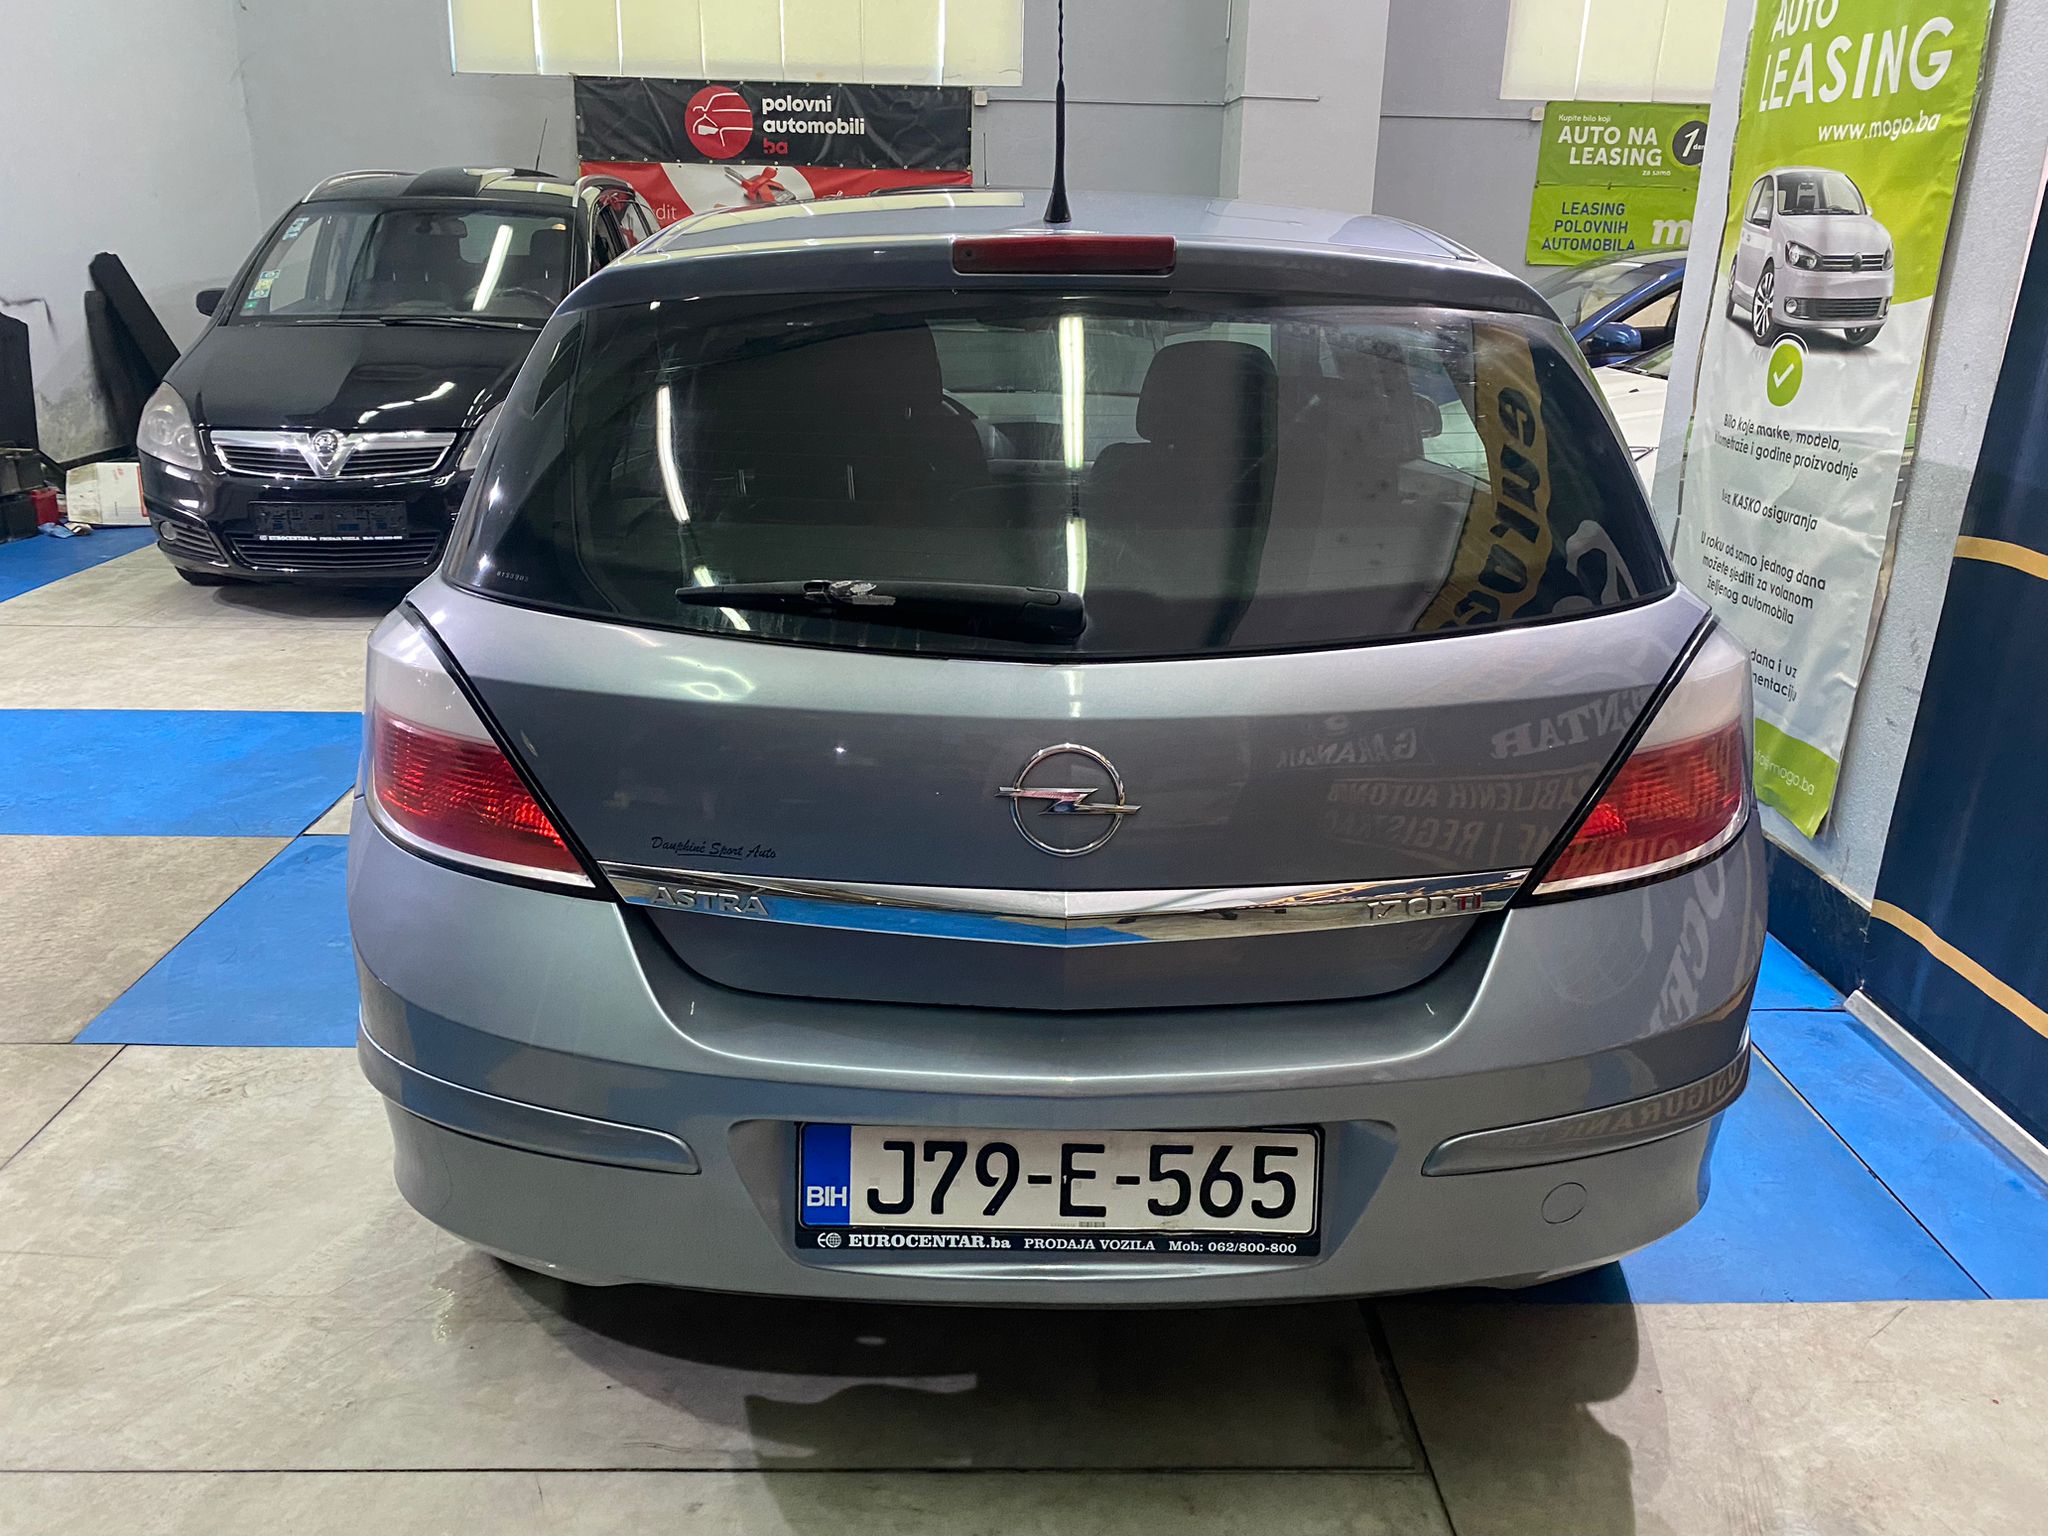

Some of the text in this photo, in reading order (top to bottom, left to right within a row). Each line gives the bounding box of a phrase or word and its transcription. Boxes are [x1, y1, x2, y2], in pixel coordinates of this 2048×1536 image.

[1771, 0, 1839, 42] AUTO
[1758, 16, 1954, 113] LEASING
[762, 95, 832, 115] polovni
[762, 117, 865, 135] automobili
[1558, 114, 1611, 123] Kupite bilo koji
[1818, 109, 1941, 142] www.mogo.ba
[1558, 125, 1658, 145] AUTO NA
[1569, 147, 1662, 166] LEASING
[655, 203, 677, 220] dit
[1562, 202, 1626, 216] LEASING
[1554, 219, 1628, 234] POLOVNIH
[1541, 237, 1635, 250] AUTOMOBILA
[1737, 417, 1754, 436] koje
[1757, 424, 1793, 443] marke,
[1796, 431, 1841, 453] modela,
[1750, 442, 1755, 455] i
[1756, 445, 1792, 463] godine
[1793, 454, 1858, 481] proizvodnje
[1732, 493, 1762, 514] KASKO
[1762, 505, 1818, 532] osiguranja
[1706, 536, 1724, 552] roku
[1735, 549, 1757, 566] samo
[1759, 555, 1794, 582] jednog
[1796, 570, 1826, 590] dana
[1729, 566, 1755, 587] sjediti
[1757, 578, 1767, 591] za
[1770, 583, 1813, 609] volanom
[1707, 575, 1794, 624] željenog automobila
[1778, 659, 1782, 673] i
[1785, 664, 1798, 678] uz
[709, 842, 743, 857] Sport
[746, 844, 777, 859] Auto
[651, 886, 769, 916] ASTRA
[866, 1140, 1299, 1219] J79-E-565
[806, 1186, 848, 1207] BIH
[848, 1233, 1297, 1254] EUROCENTAR.ba PRODAJA VOZILA Mob: 062/800-800
